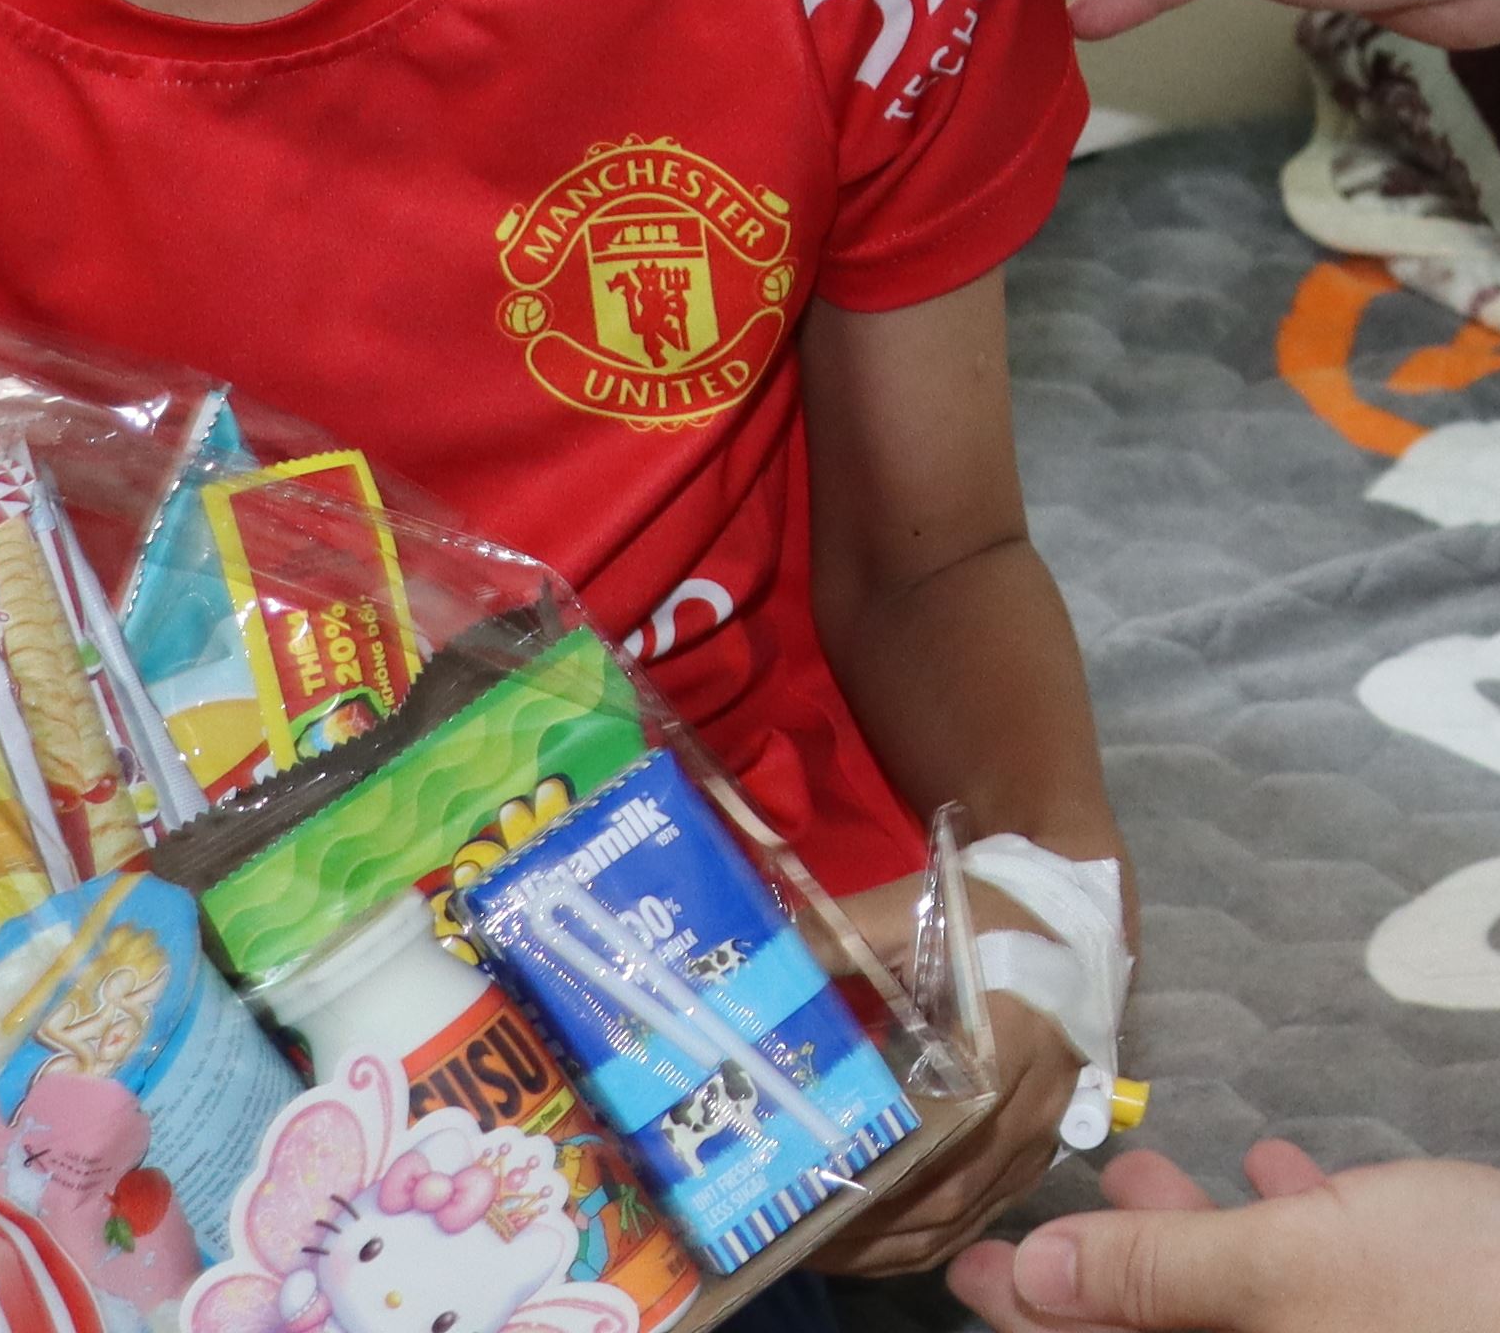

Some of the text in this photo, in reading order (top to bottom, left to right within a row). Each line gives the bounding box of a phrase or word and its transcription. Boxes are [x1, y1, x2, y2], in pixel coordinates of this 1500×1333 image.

[523, 157, 766, 264] MANCHESTER
[583, 359, 750, 409] UNITED
[320, 600, 363, 686] 20%
[371, 640, 396, 708] KHÔNG
